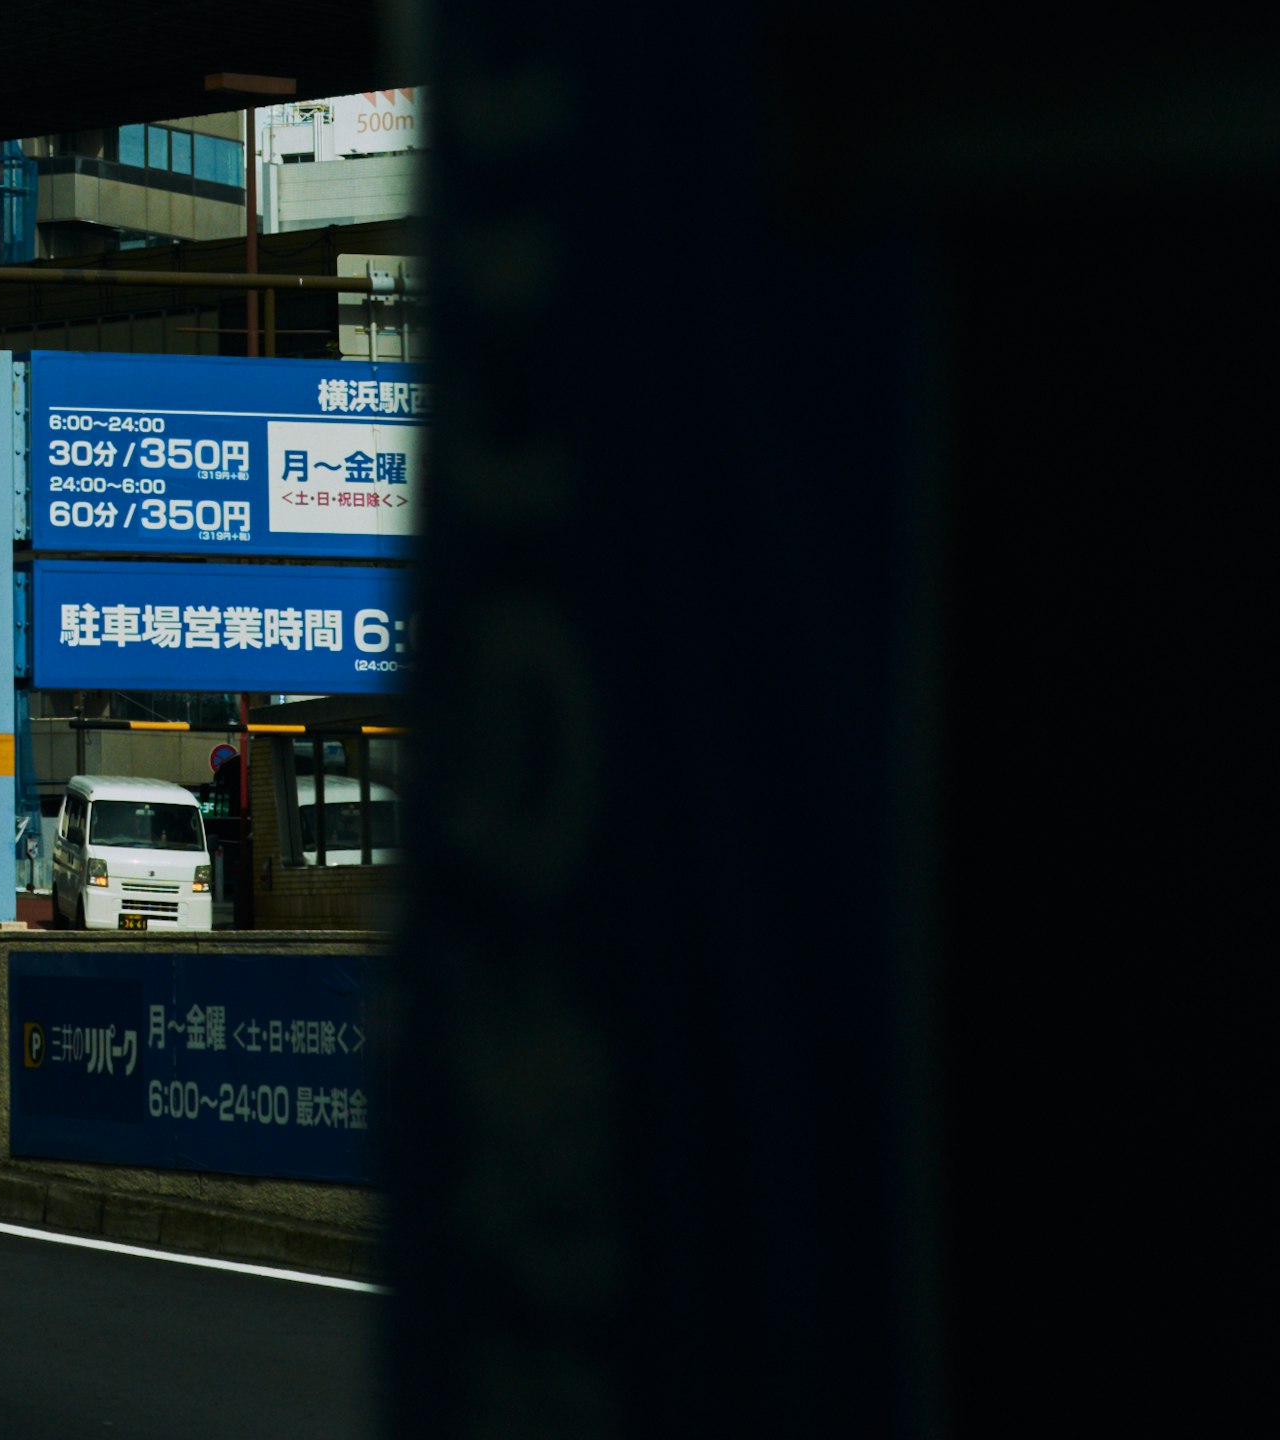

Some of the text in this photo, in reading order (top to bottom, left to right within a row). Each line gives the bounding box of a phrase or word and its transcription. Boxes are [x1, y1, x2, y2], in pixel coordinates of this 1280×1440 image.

[357, 112, 414, 133] 500m
[49, 416, 165, 433] 6:00〜24:00
[50, 477, 166, 494] 24:00〜6:00
[282, 450, 407, 485] 月〜金曜
[60, 603, 342, 652] 駐車場営業時間
[148, 1004, 226, 1051] 月〜金曜
[52, 1023, 138, 1077] 三井のリパーク
[148, 1079, 368, 1130] 6:00〜24:00 最大料金
